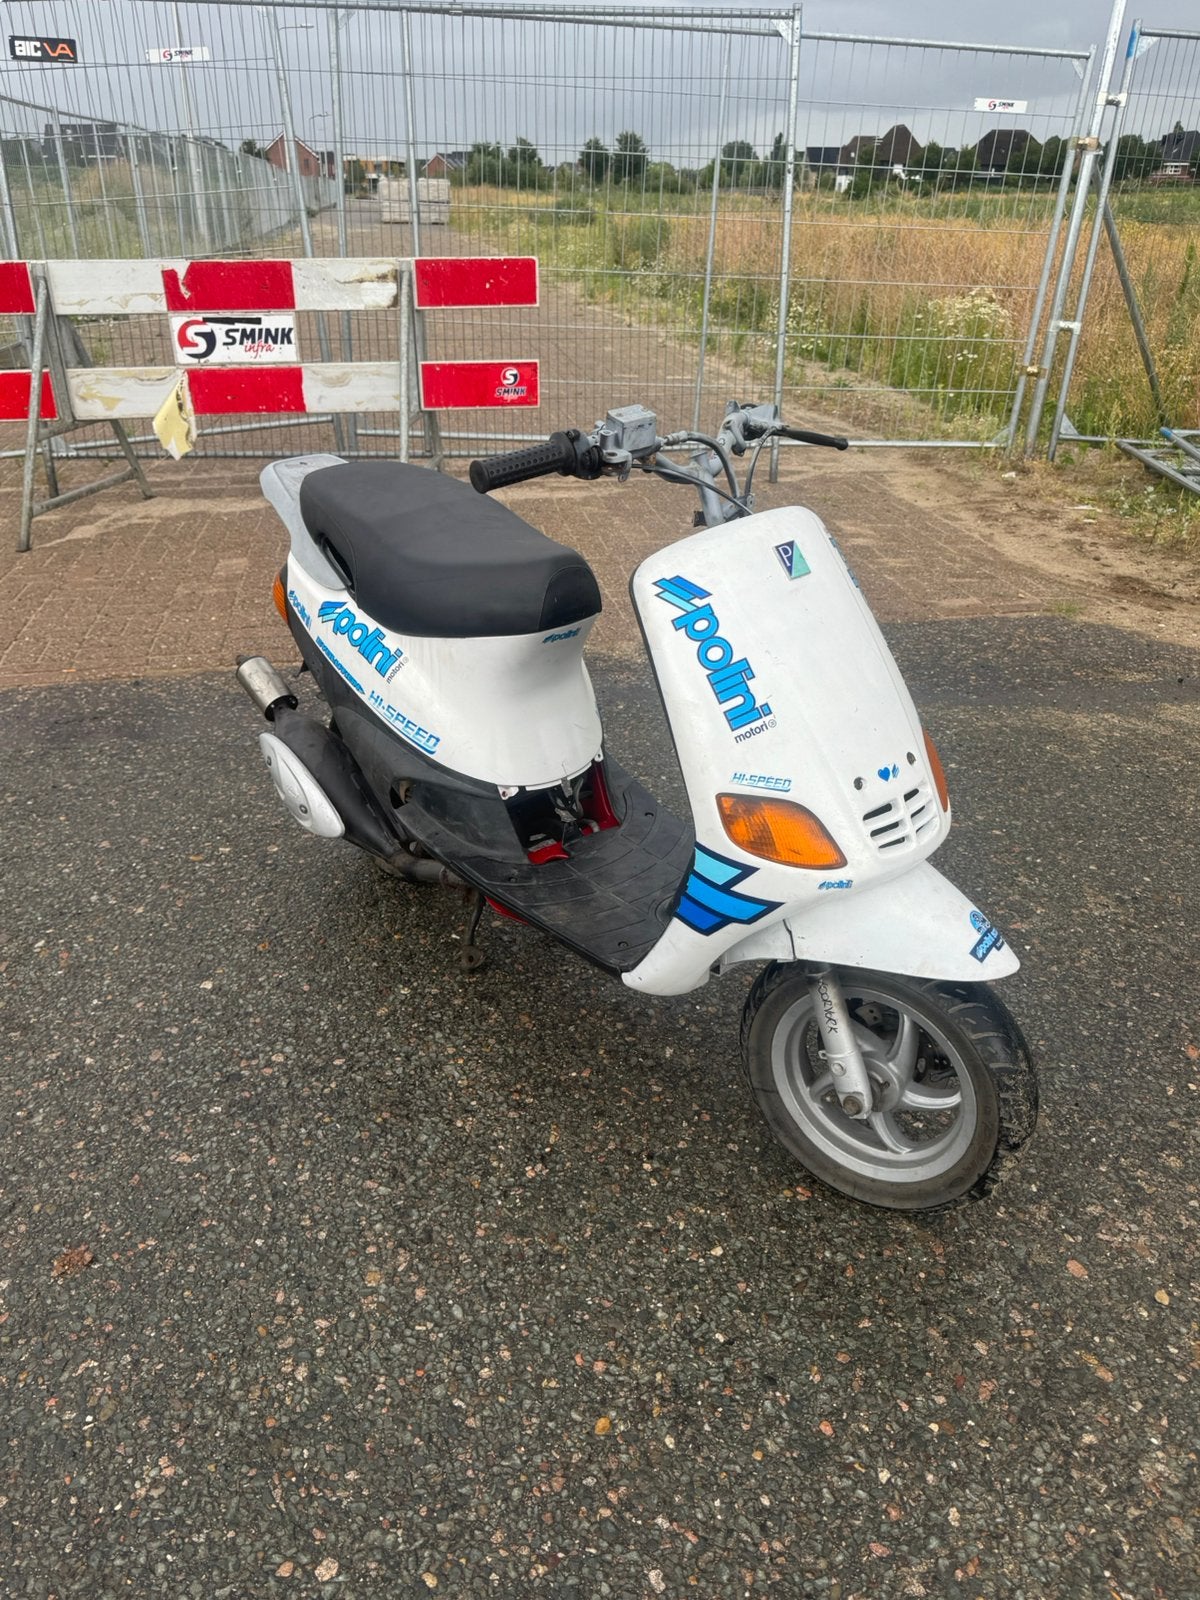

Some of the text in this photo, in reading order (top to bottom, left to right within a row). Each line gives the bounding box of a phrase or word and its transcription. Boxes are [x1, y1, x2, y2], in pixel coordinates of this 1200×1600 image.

[222, 327, 293, 346] SMINK
[244, 339, 275, 359] infra
[496, 387, 527, 397] SMINK
[333, 606, 404, 678] polini
[671, 602, 773, 732] polini
